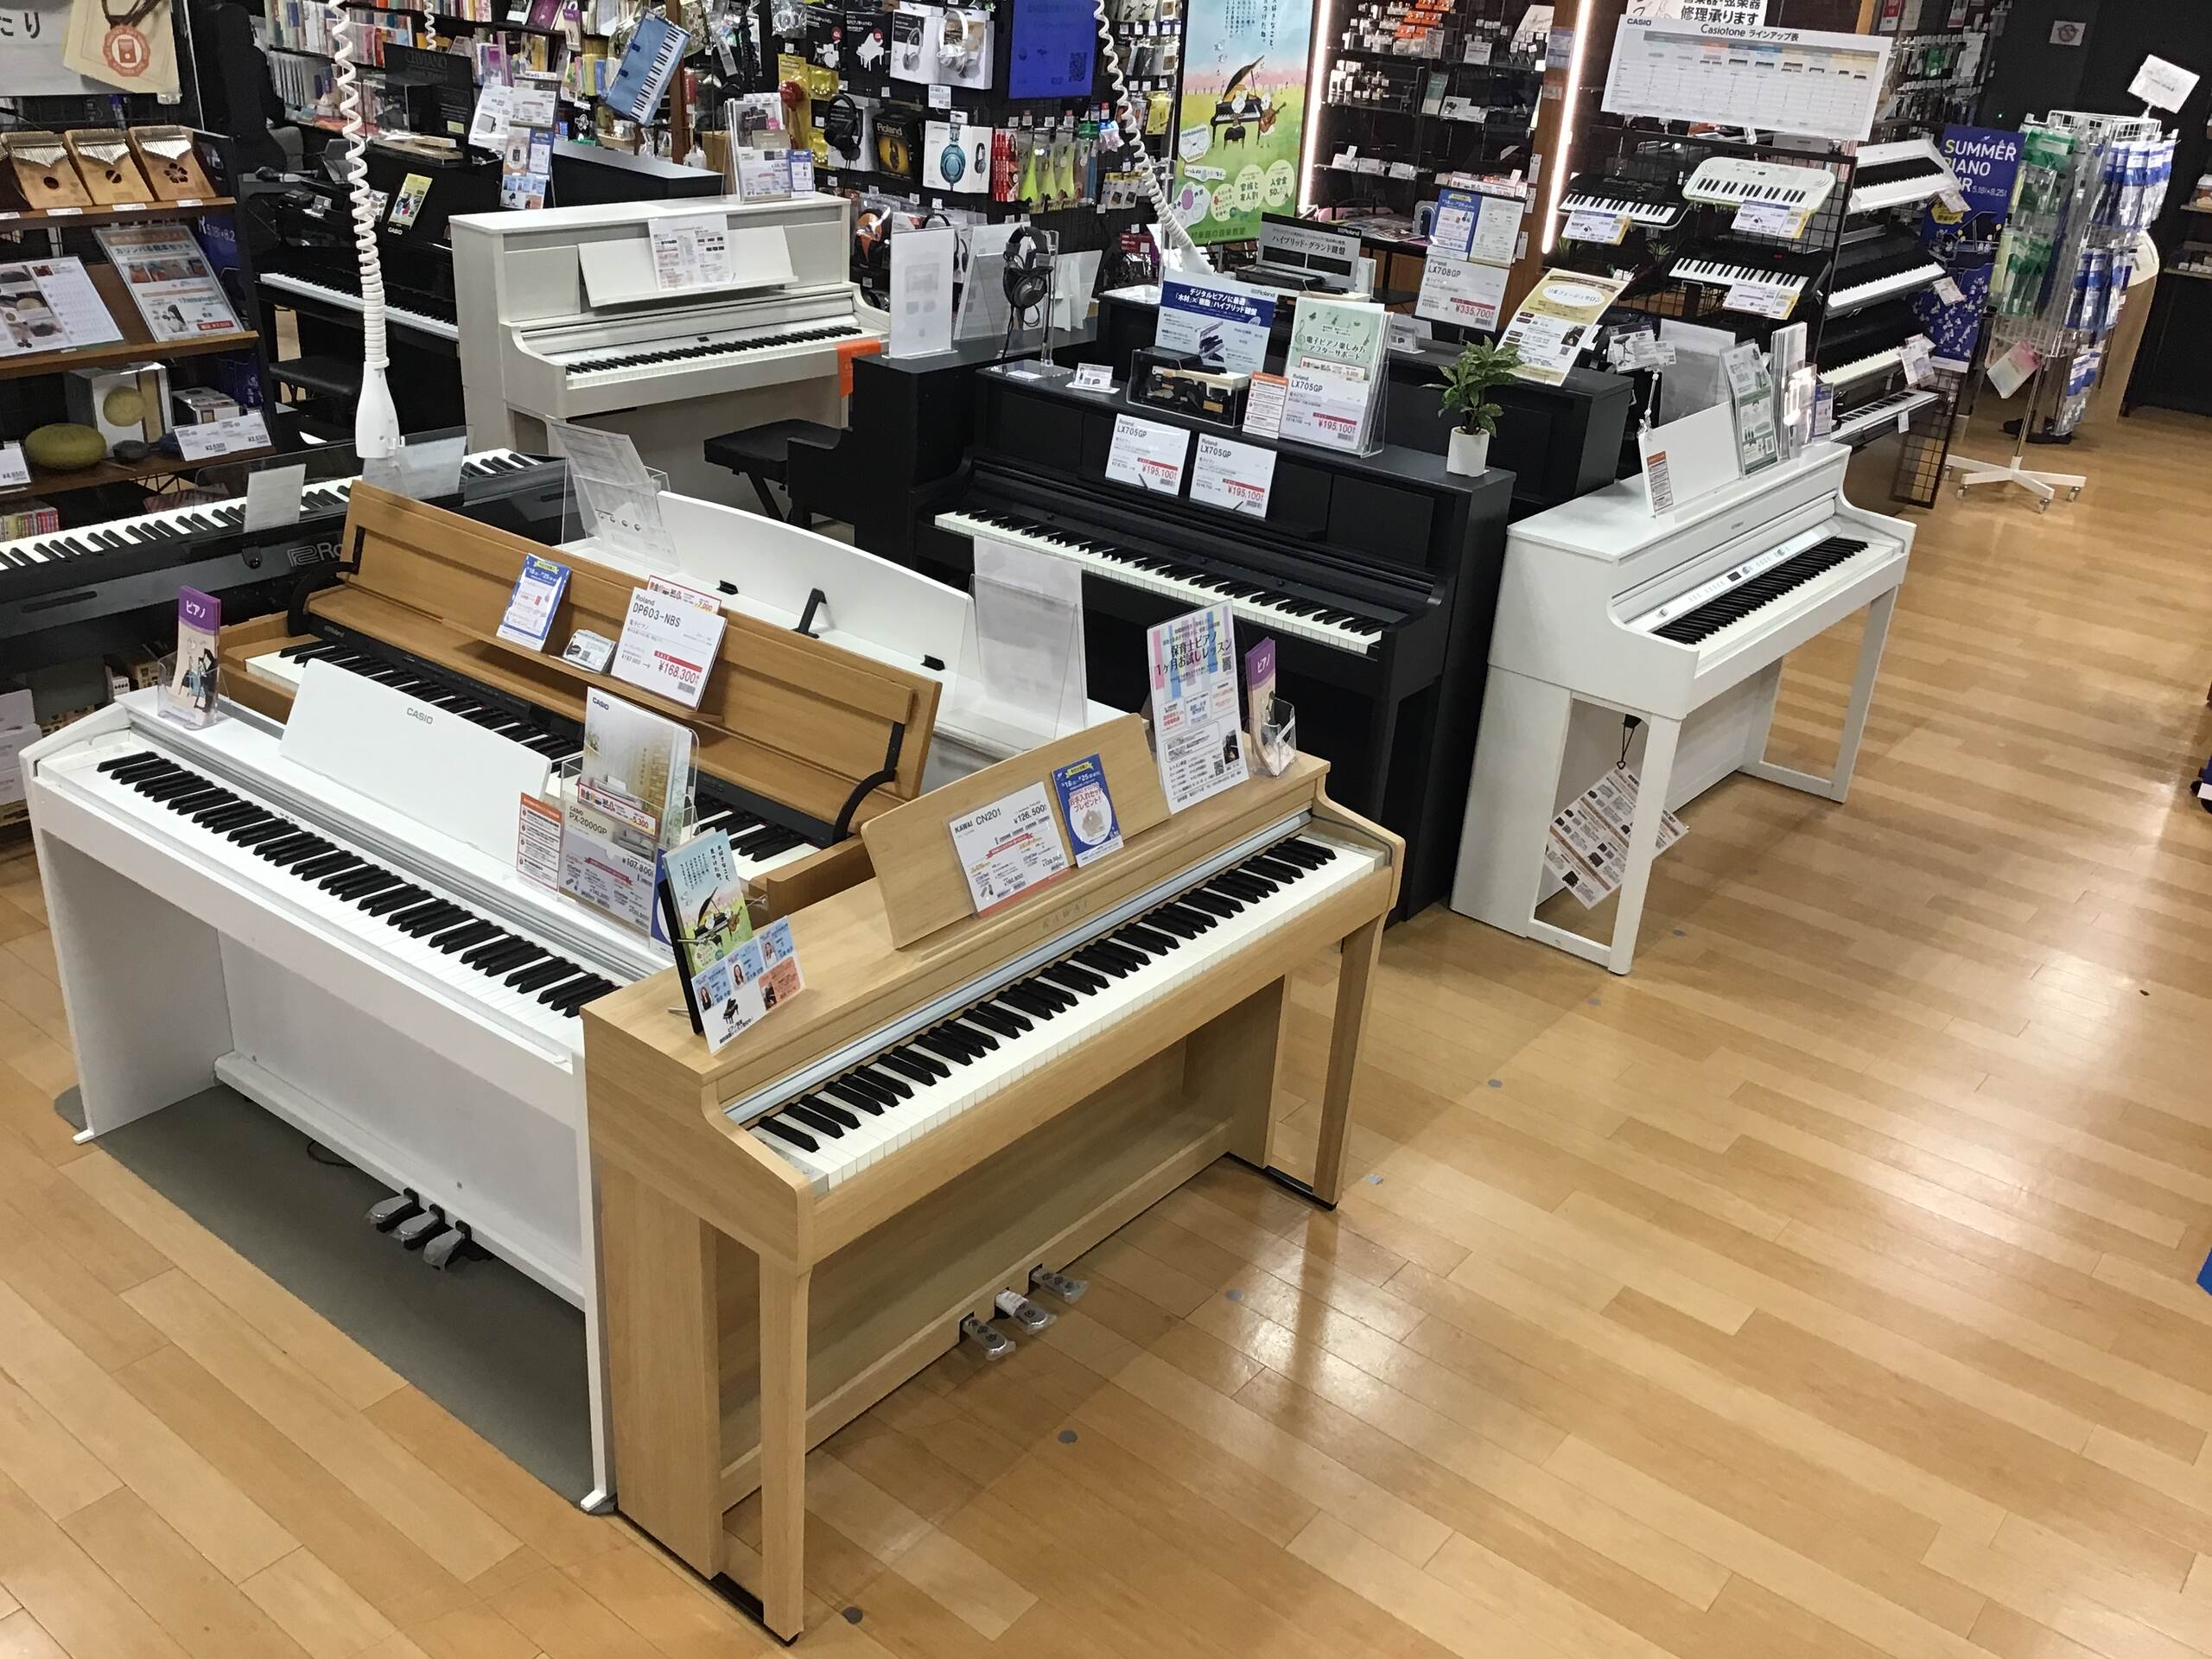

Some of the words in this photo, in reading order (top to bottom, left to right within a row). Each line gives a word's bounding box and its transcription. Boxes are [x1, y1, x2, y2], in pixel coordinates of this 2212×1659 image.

[1681, 5, 1759, 26] 修理承ります
[1700, 24, 1745, 37] Casiotone
[1749, 29, 1800, 42] ラインアップ表
[876, 122, 903, 137] Roland
[1944, 139, 2017, 162] SUMMER
[1427, 265, 1461, 278] LX708GP
[1306, 336, 1366, 353] 電子ピアノ楽しみ方
[1308, 345, 1361, 360] アフターサポート
[1291, 380, 1323, 392] LX705GP
[1117, 426, 1147, 438] LX705GP
[1200, 445, 1231, 458] LX705GP
[636, 594, 655, 606] Roland
[186, 600, 206, 619] ピアノ
[632, 602, 681, 627] DP603-NBS
[1171, 631, 1217, 658] 保育士ピアノ
[1257, 654, 1271, 674] ピアノ
[592, 696, 609, 710] CASIO
[406, 707, 433, 724] CASIO
[569, 805, 583, 816] CASIO
[569, 811, 607, 836] PX-2000GP
[954, 820, 973, 834] KAWAI
[976, 807, 1001, 825] CN201
